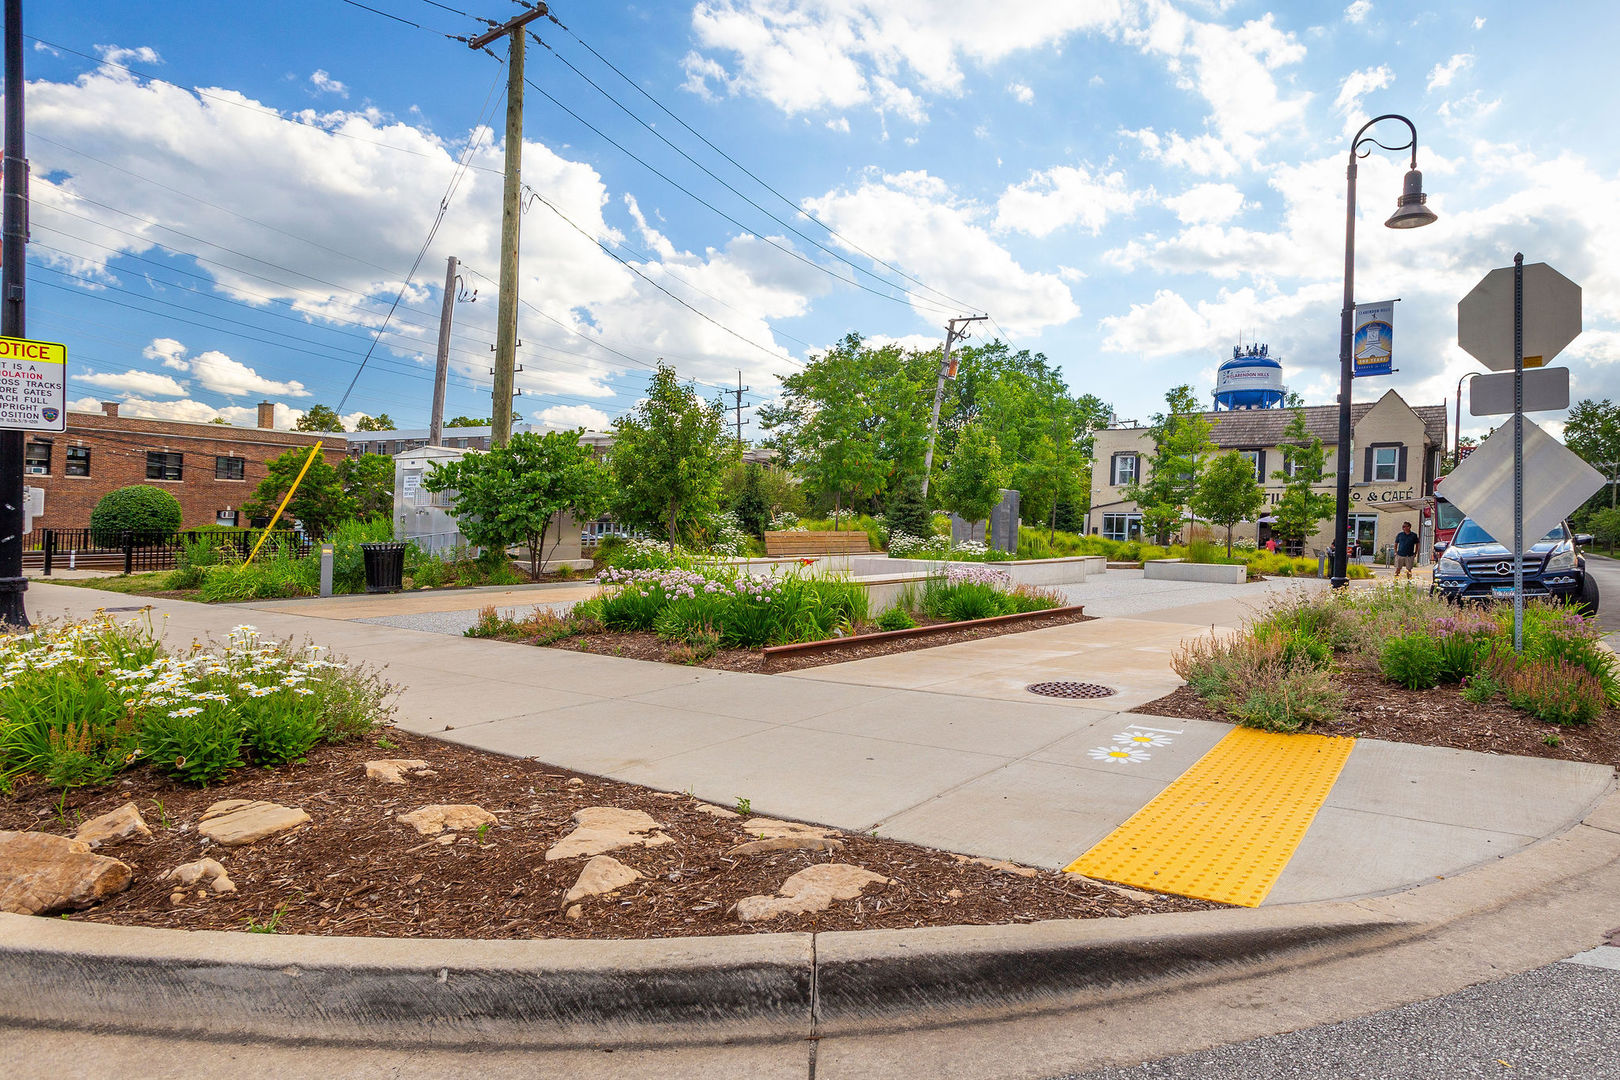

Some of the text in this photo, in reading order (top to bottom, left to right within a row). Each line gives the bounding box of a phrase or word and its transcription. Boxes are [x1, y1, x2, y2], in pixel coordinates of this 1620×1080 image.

[0, 341, 50, 359] OTICE
[0, 370, 43, 380] OLATION
[0, 378, 62, 390] OSS TRACKS
[0, 386, 53, 397] ORE GATES
[0, 394, 48, 405] ACH FULL
[1, 410, 40, 420] OSITION
[1367, 491, 1378, 502] &
[1382, 486, 1413, 502] CAFÉ
